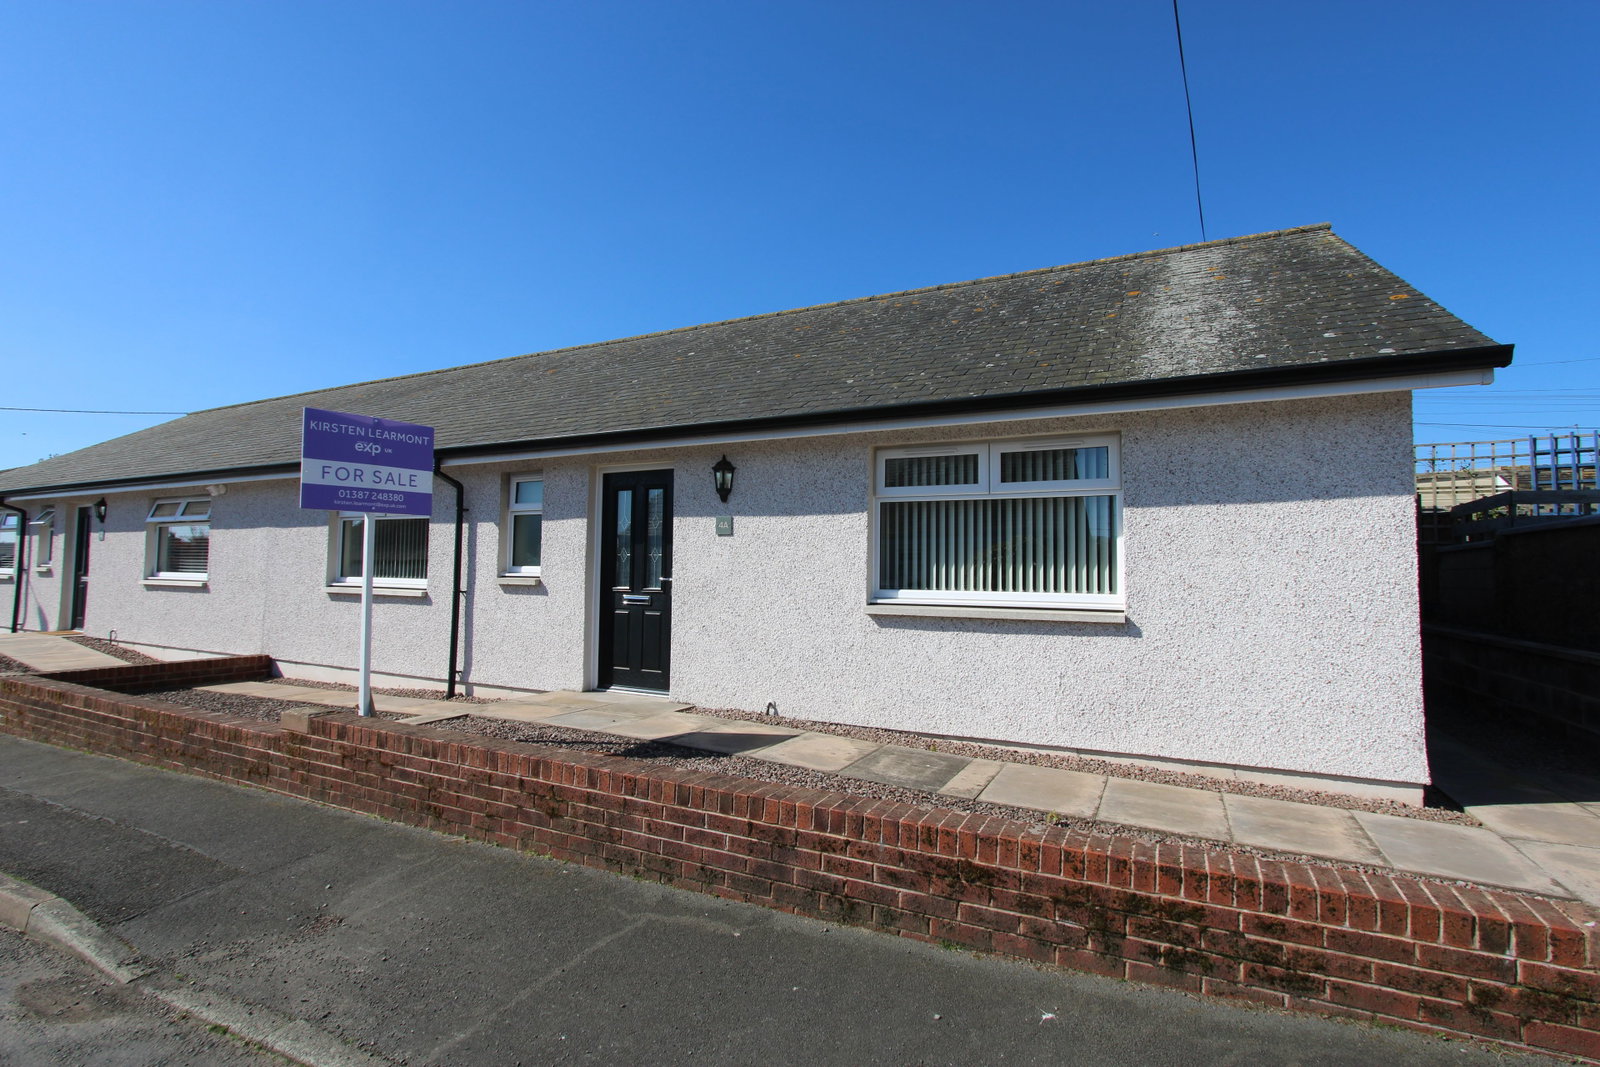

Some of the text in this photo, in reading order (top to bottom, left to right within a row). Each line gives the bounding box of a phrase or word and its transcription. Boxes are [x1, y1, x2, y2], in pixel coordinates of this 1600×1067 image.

[310, 420, 430, 446] KIRSTEN LEARMONT
[355, 441, 381, 456] exp
[321, 466, 417, 487] FOR SALE
[338, 489, 404, 502] 01387 248380
